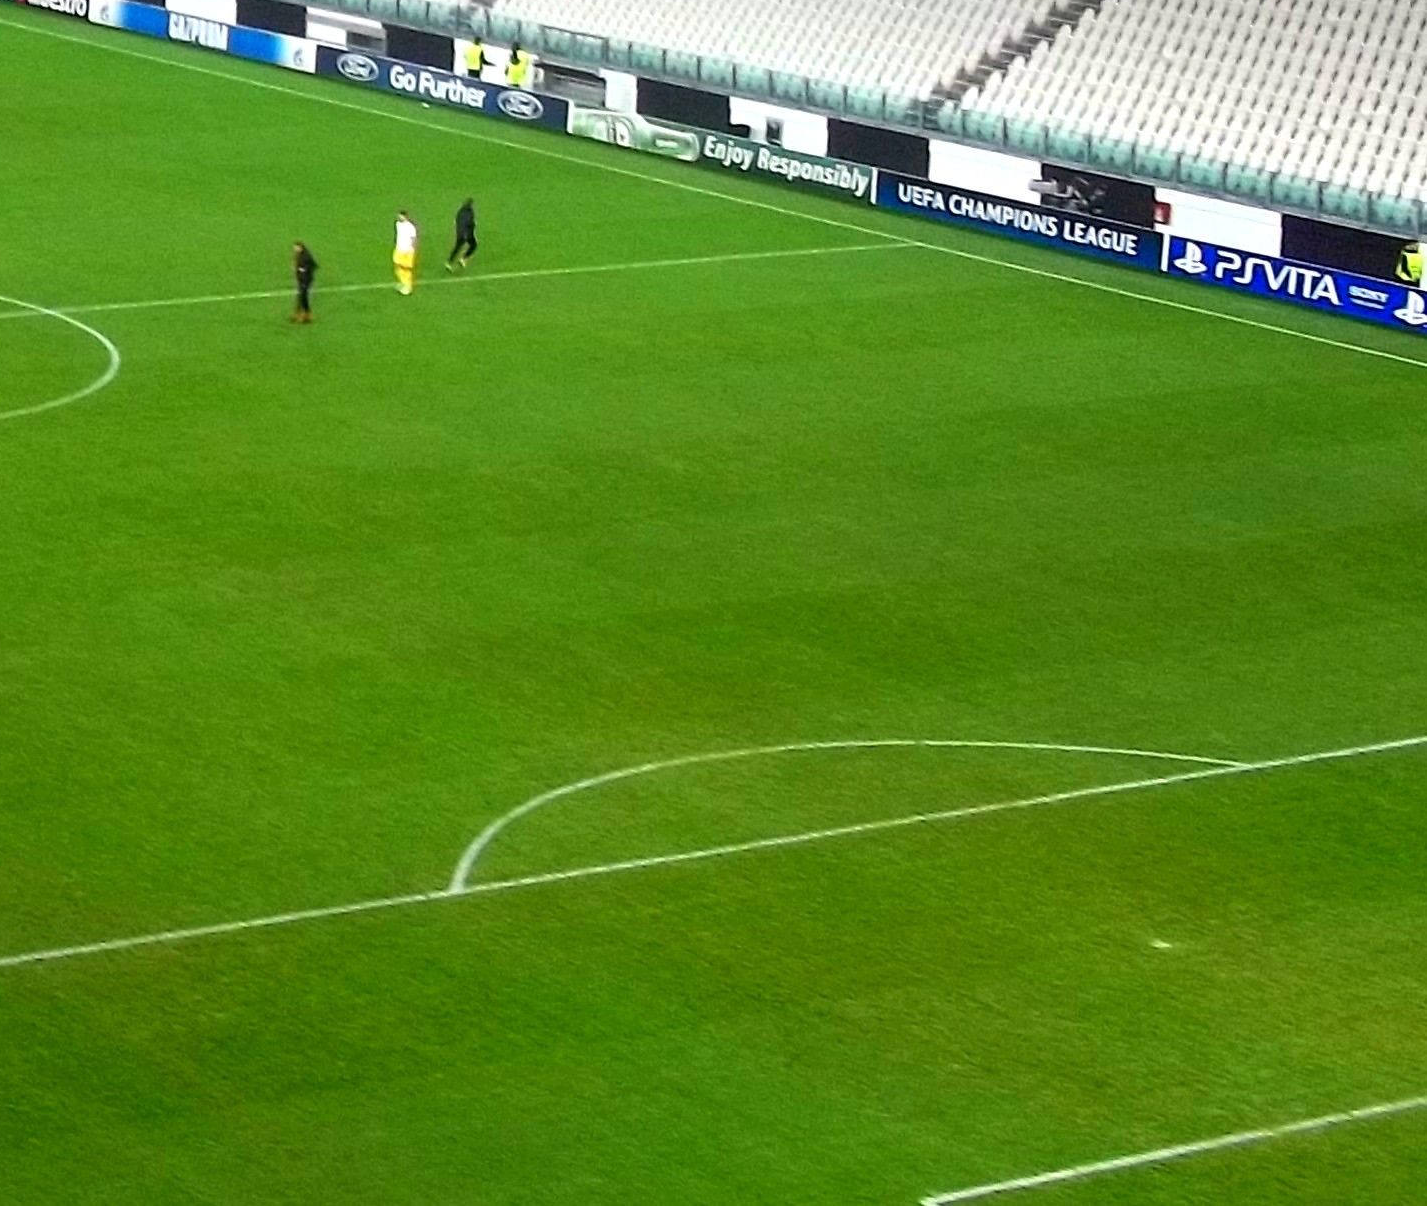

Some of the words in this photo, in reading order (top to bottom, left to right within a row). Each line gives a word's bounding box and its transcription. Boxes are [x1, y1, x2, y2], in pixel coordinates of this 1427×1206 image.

[389, 65, 416, 92] Go
[418, 70, 486, 109] Further
[703, 136, 755, 171] Enjoy
[756, 147, 871, 198] Responsibly
[897, 181, 945, 212] UEFA
[948, 194, 1059, 238] CHAMPIONS
[1062, 219, 1139, 257] LEAGUE
